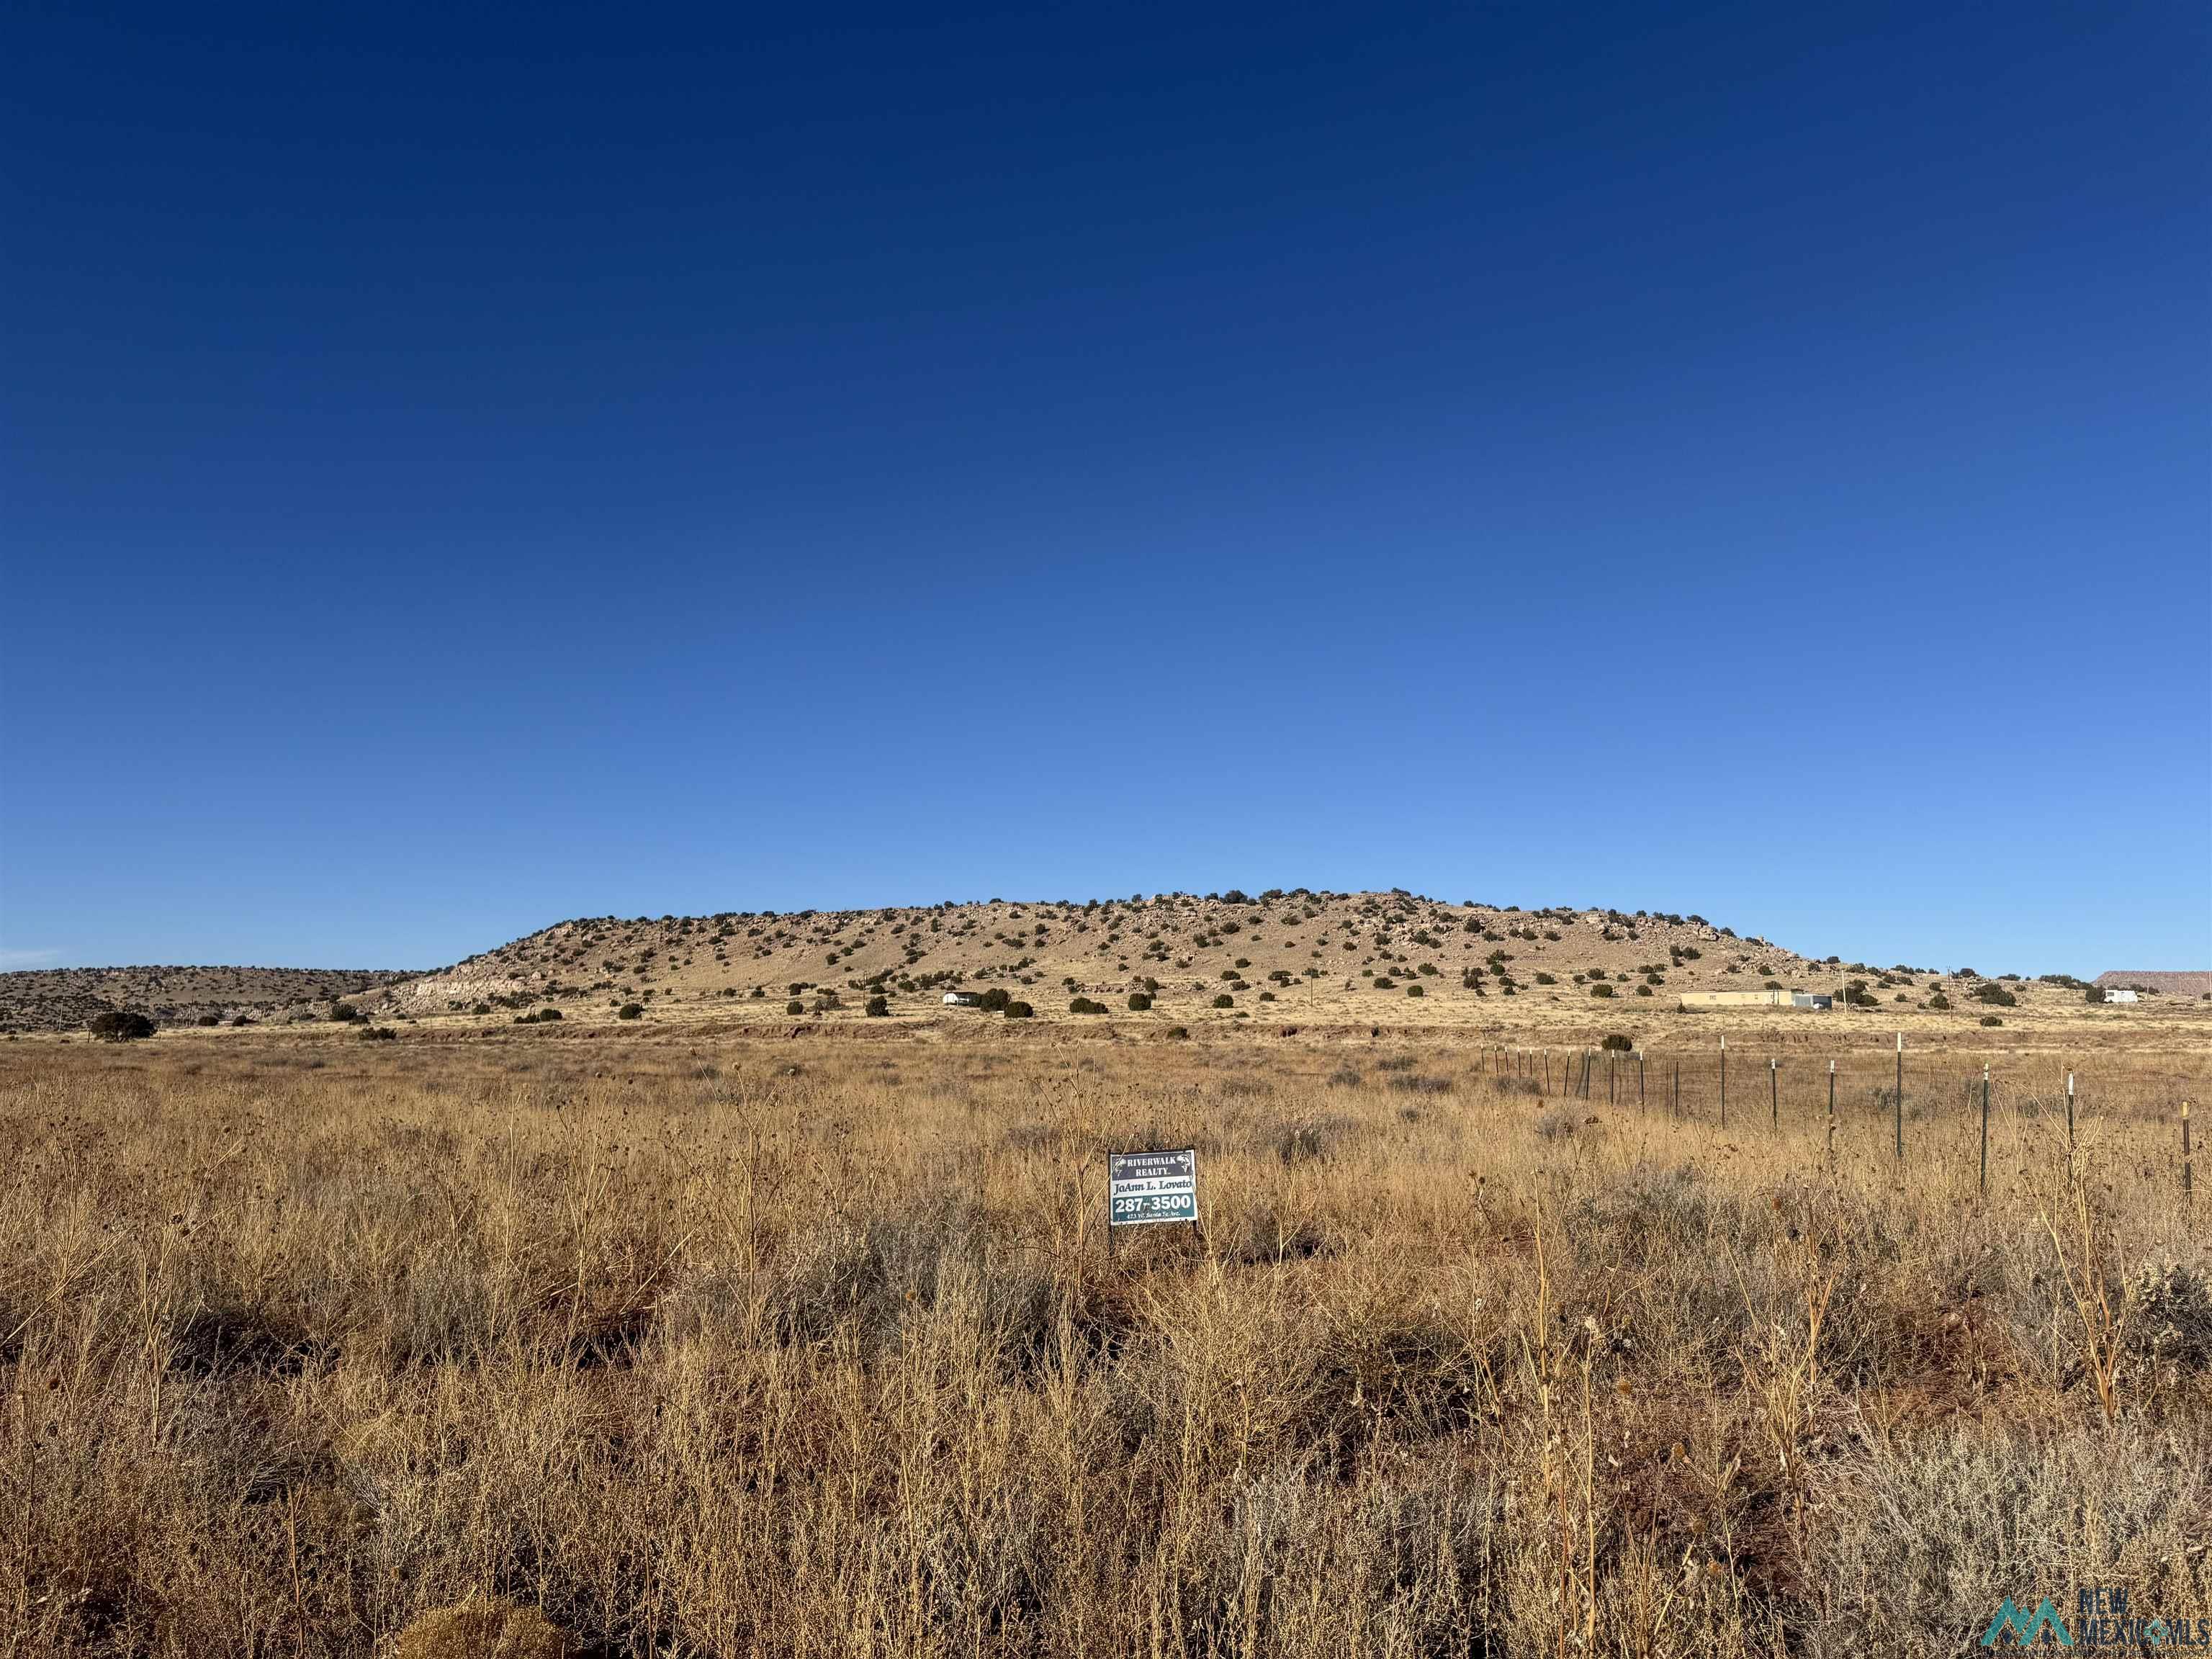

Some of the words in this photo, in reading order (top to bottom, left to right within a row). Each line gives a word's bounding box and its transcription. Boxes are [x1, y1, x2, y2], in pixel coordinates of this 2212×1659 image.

[1127, 1156, 1177, 1167] RIVERWALK
[1136, 1167, 1168, 1177] REALTY
[1113, 1182, 1144, 1195] JoAnn
[1146, 1181, 1156, 1190] L.
[1159, 1179, 1192, 1190] Lovato
[1115, 1195, 1191, 1213] 287-3500
